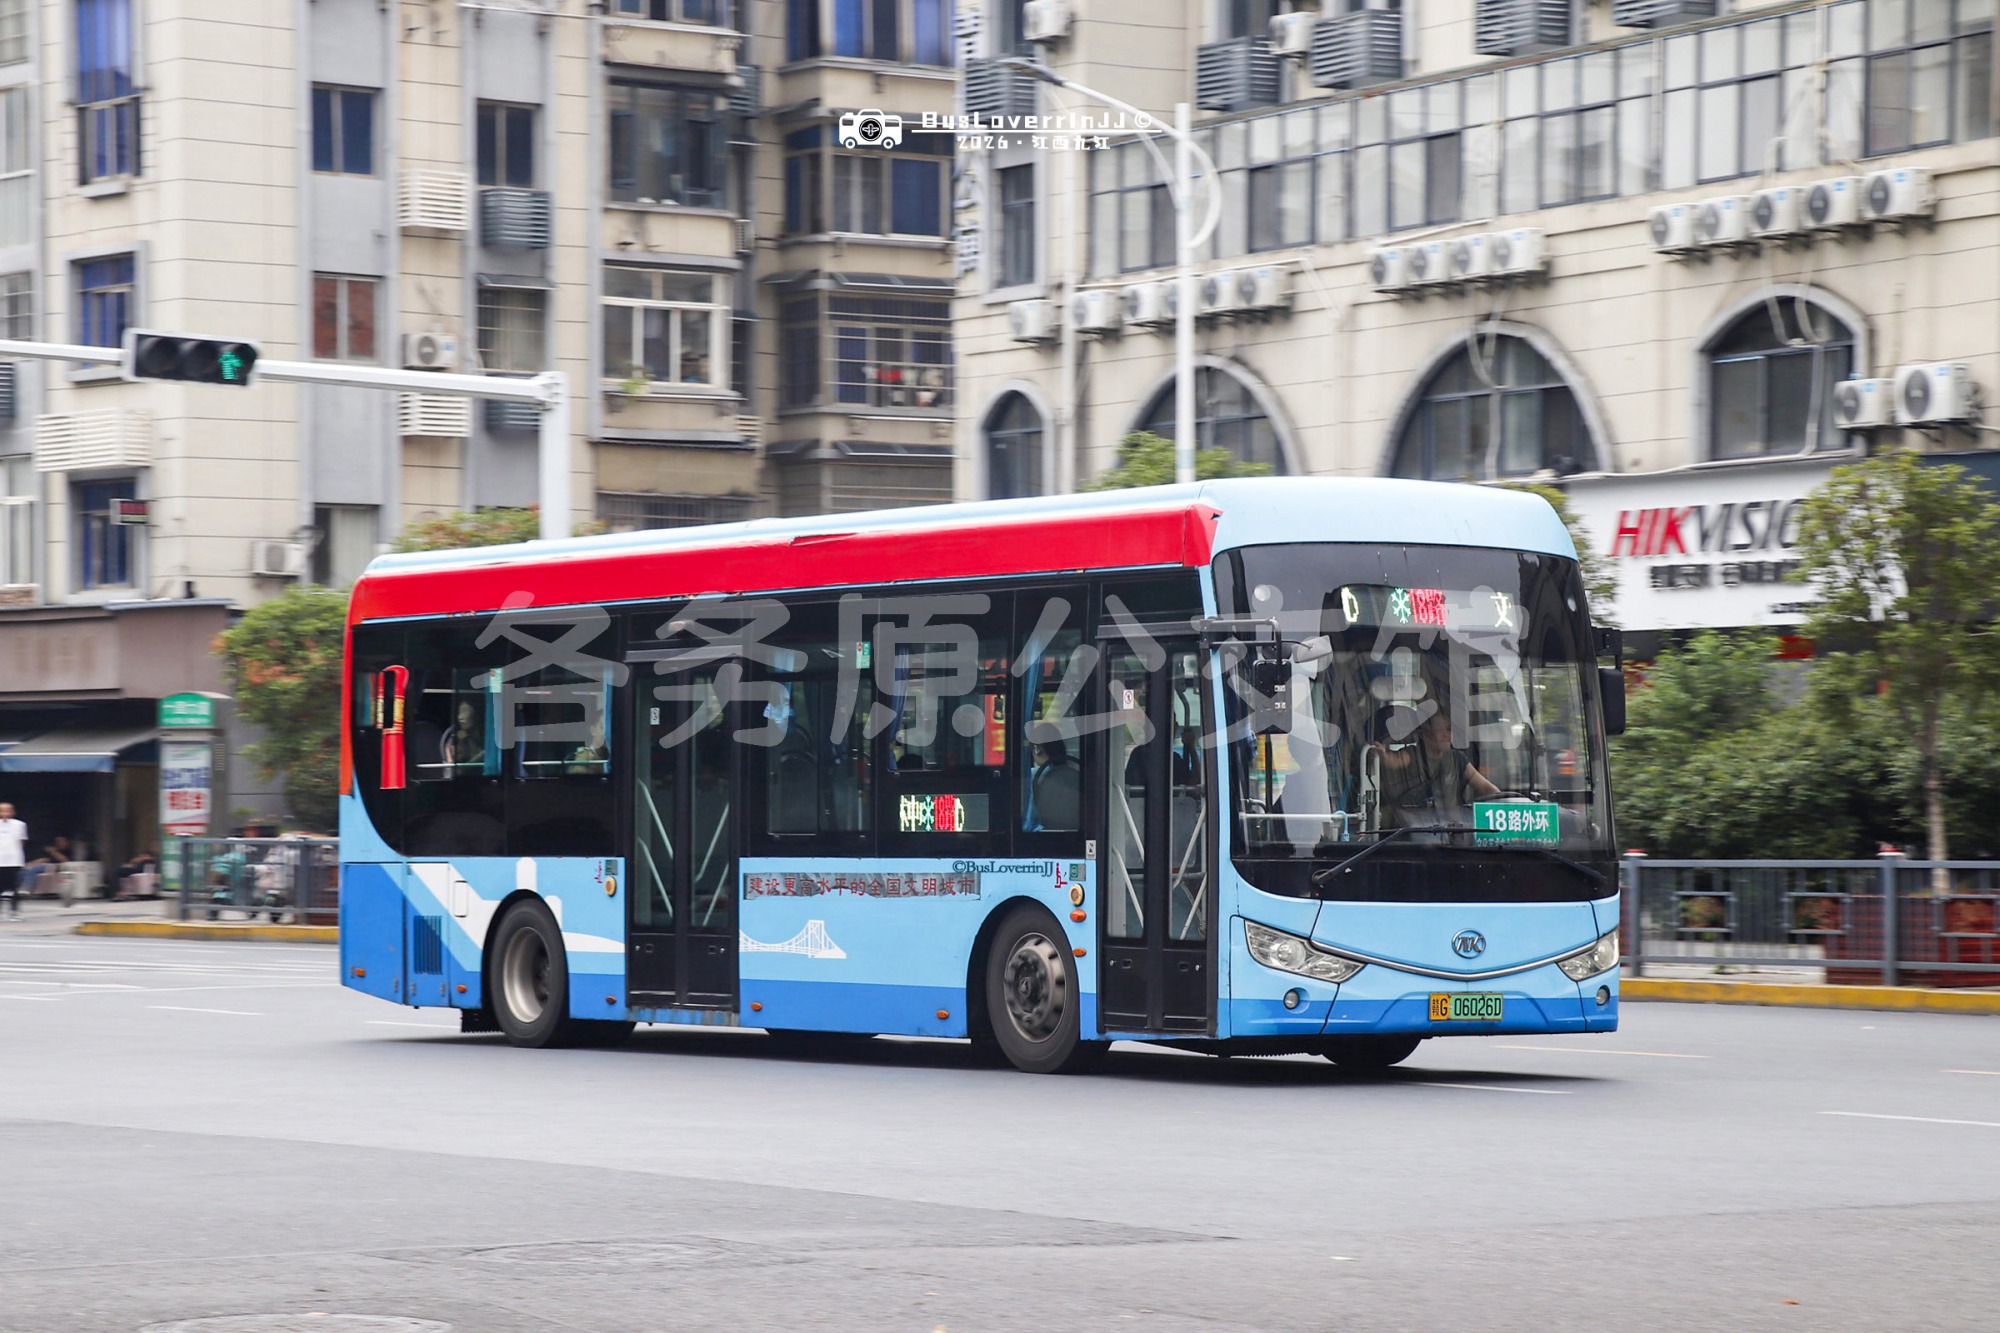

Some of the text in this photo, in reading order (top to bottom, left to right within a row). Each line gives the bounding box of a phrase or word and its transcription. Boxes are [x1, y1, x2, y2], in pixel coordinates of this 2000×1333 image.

[1485, 808, 1550, 833] 18路外环
[748, 876, 976, 896] 建设更高水平的全国文明城市
